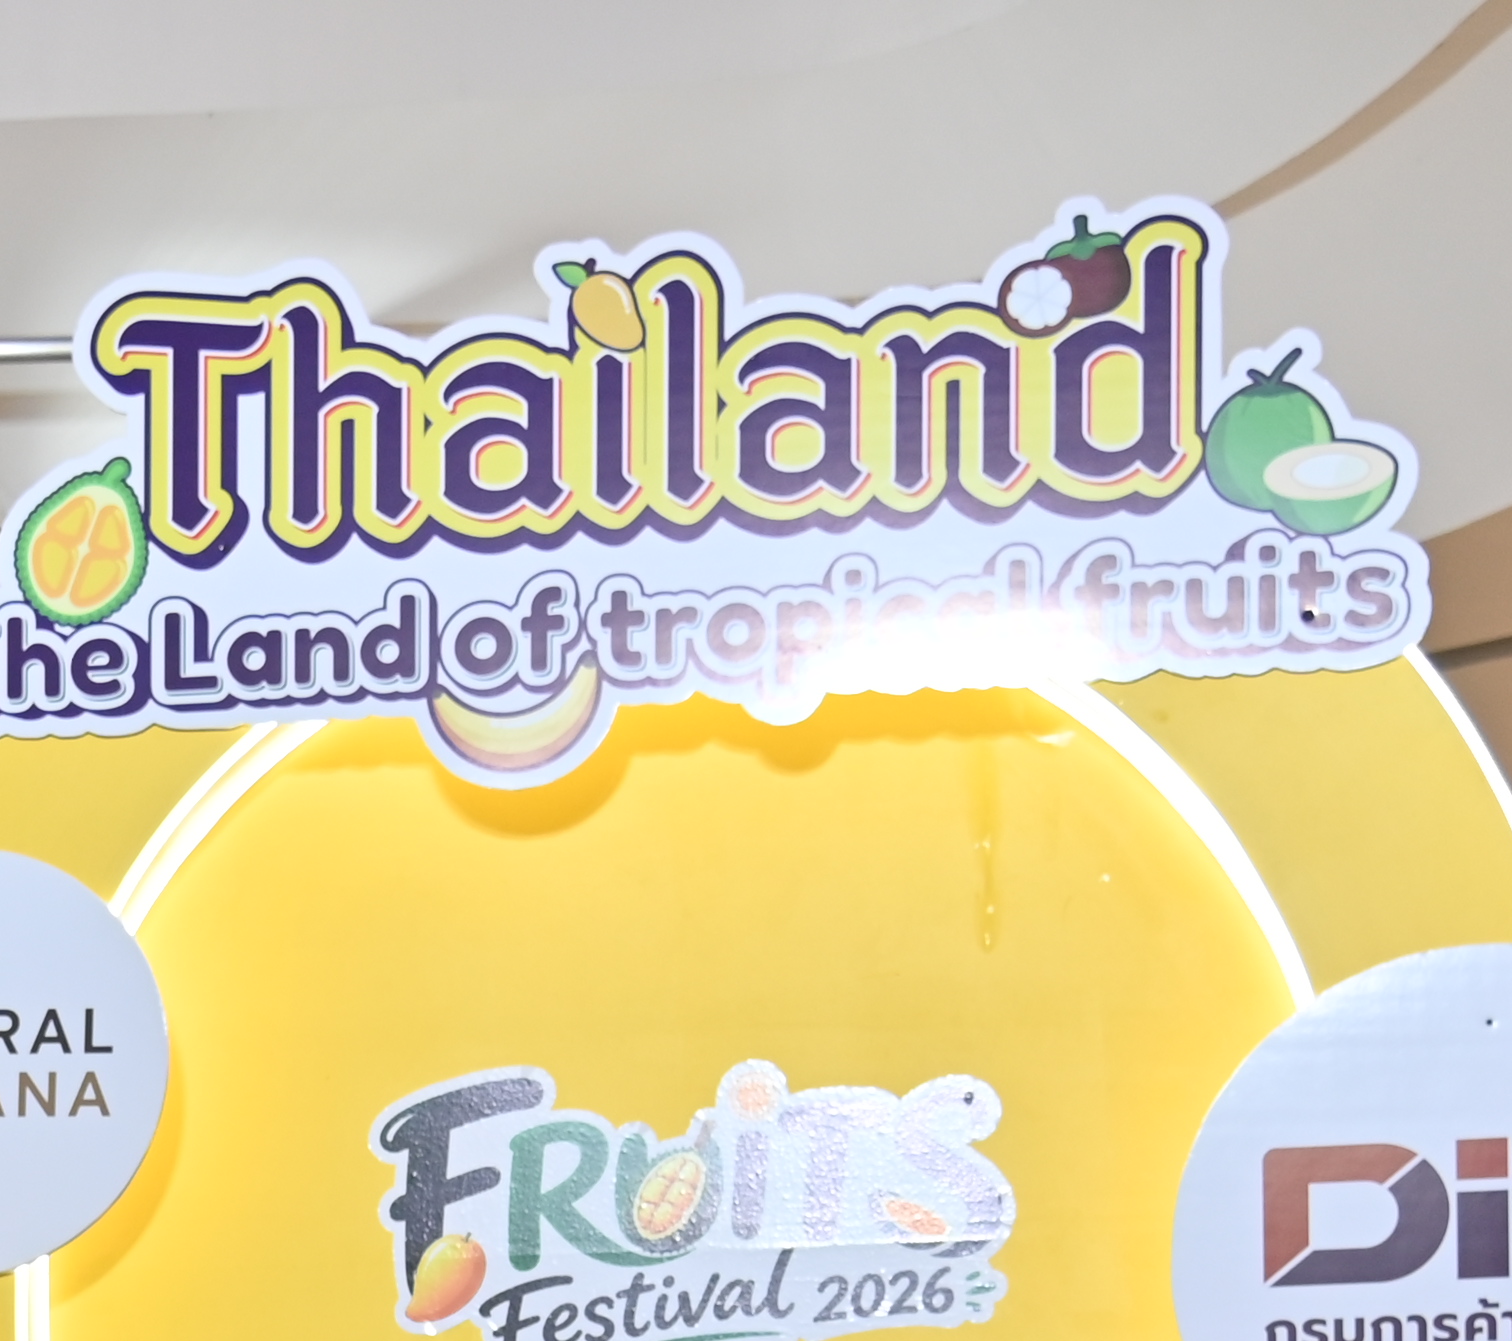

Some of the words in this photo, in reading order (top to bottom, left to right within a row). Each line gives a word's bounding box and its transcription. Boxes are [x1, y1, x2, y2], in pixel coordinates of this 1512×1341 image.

[101, 222, 1202, 556] Thailand
[161, 594, 417, 697] Land
[452, 585, 568, 678] of
[1074, 542, 1403, 656] fruits
[812, 1264, 957, 1324] 2026
